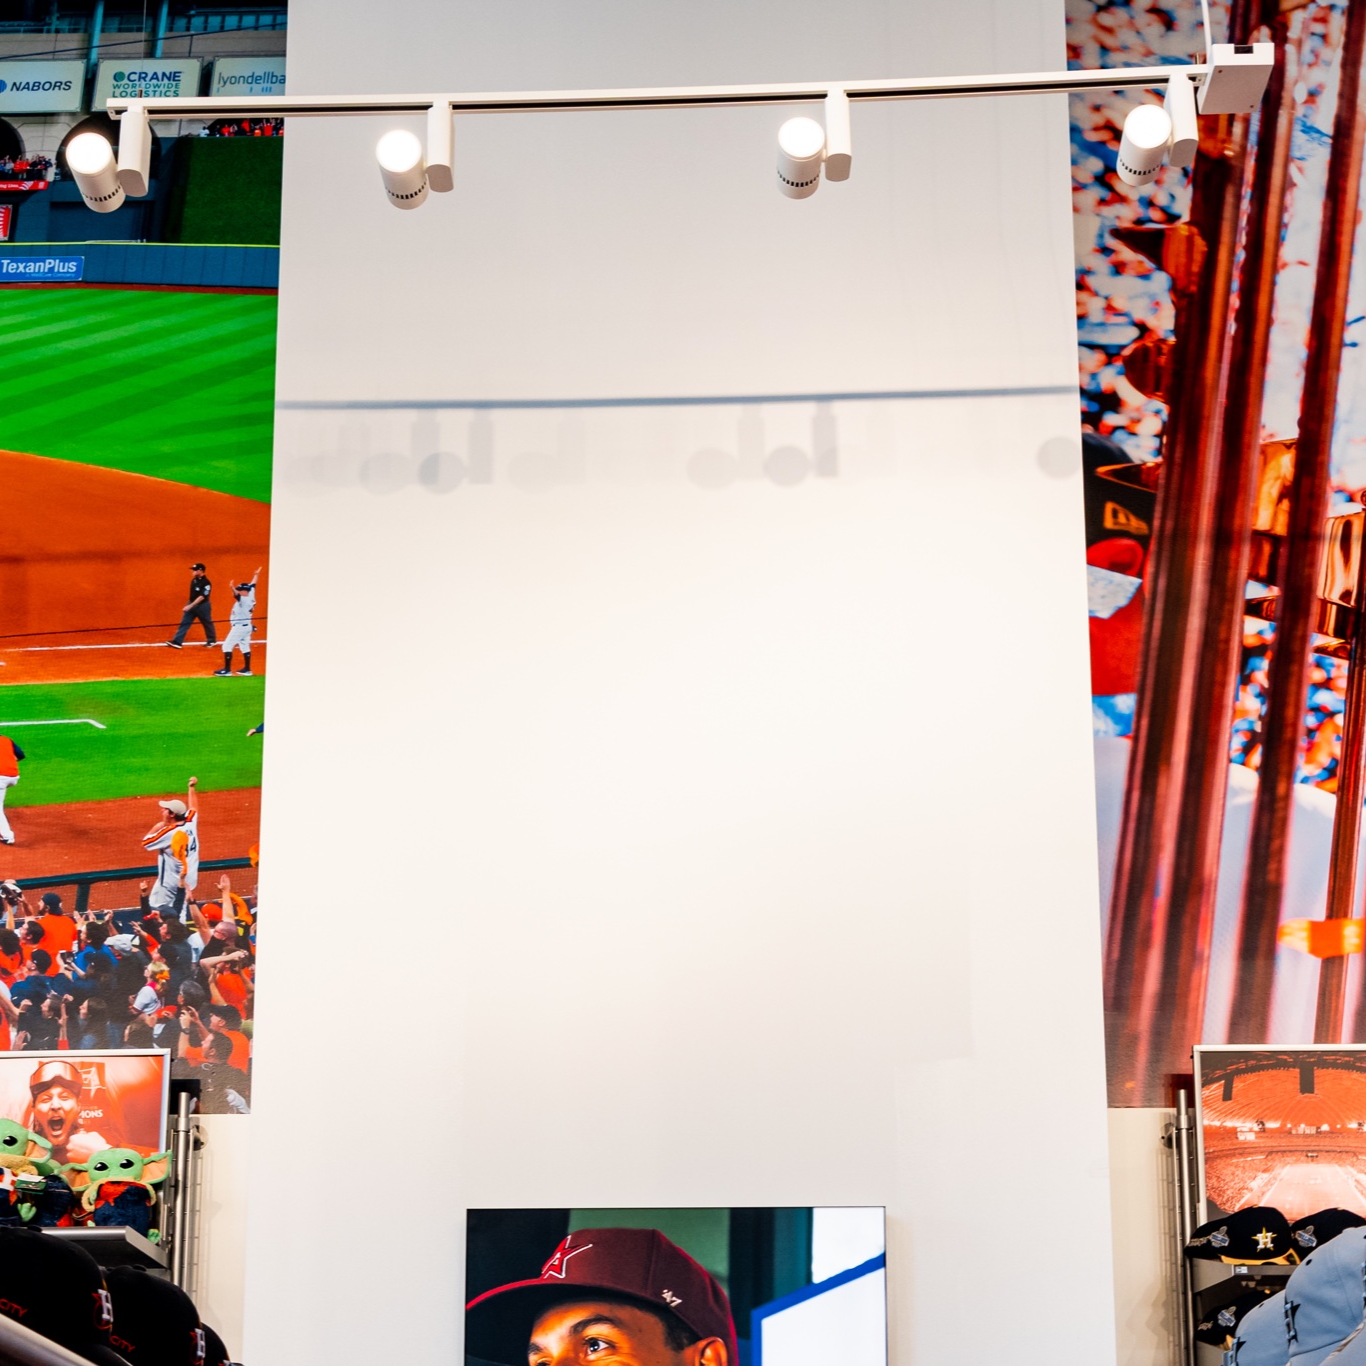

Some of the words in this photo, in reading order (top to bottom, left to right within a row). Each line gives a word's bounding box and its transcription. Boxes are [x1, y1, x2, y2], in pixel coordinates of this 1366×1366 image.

[128, 71, 182, 82] CRANE
[10, 80, 73, 92] NABORS
[112, 82, 180, 90] WORLDWIDE
[112, 89, 180, 98] LOGSTICS
[0, 259, 78, 274] TexanPlus
